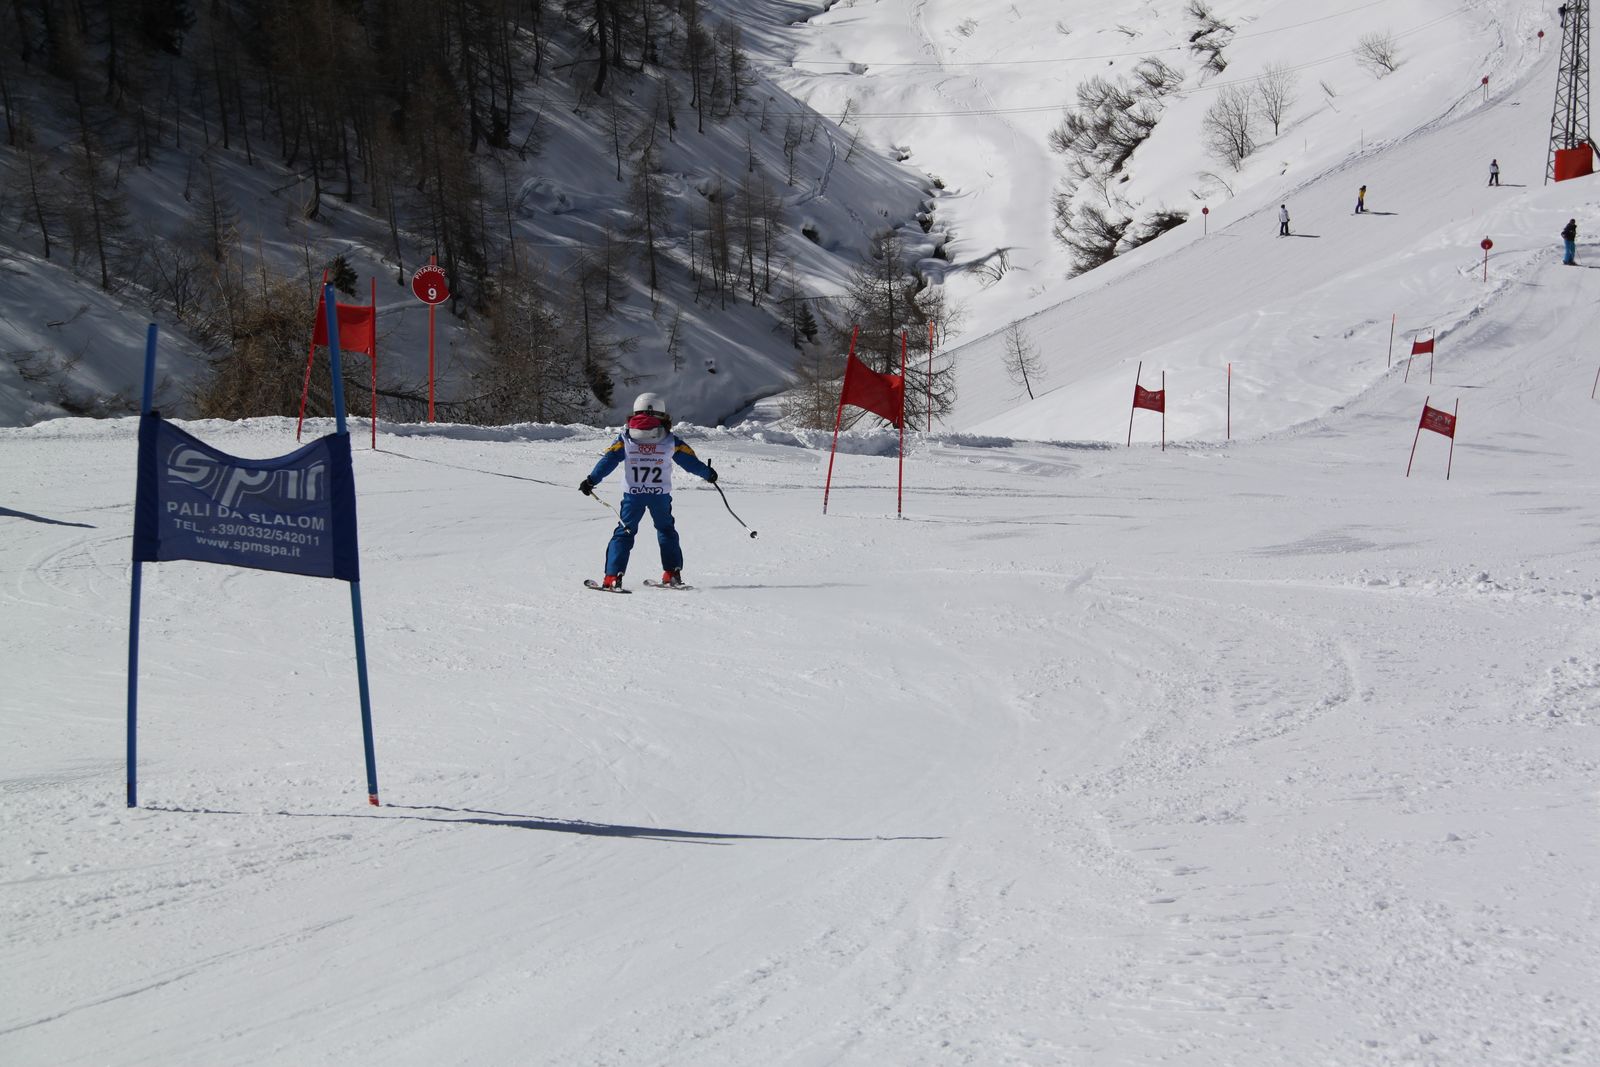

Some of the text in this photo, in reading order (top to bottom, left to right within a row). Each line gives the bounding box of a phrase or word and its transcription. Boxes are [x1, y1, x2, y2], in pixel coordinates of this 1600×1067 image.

[415, 266, 446, 279] PITAROCC
[428, 288, 437, 300] 9
[631, 467, 662, 483] 172
[167, 501, 325, 531] PALI DA SLALOM
[173, 519, 320, 546] TEL. +39/0332/542011
[196, 535, 301, 557] www.spmspa.it
